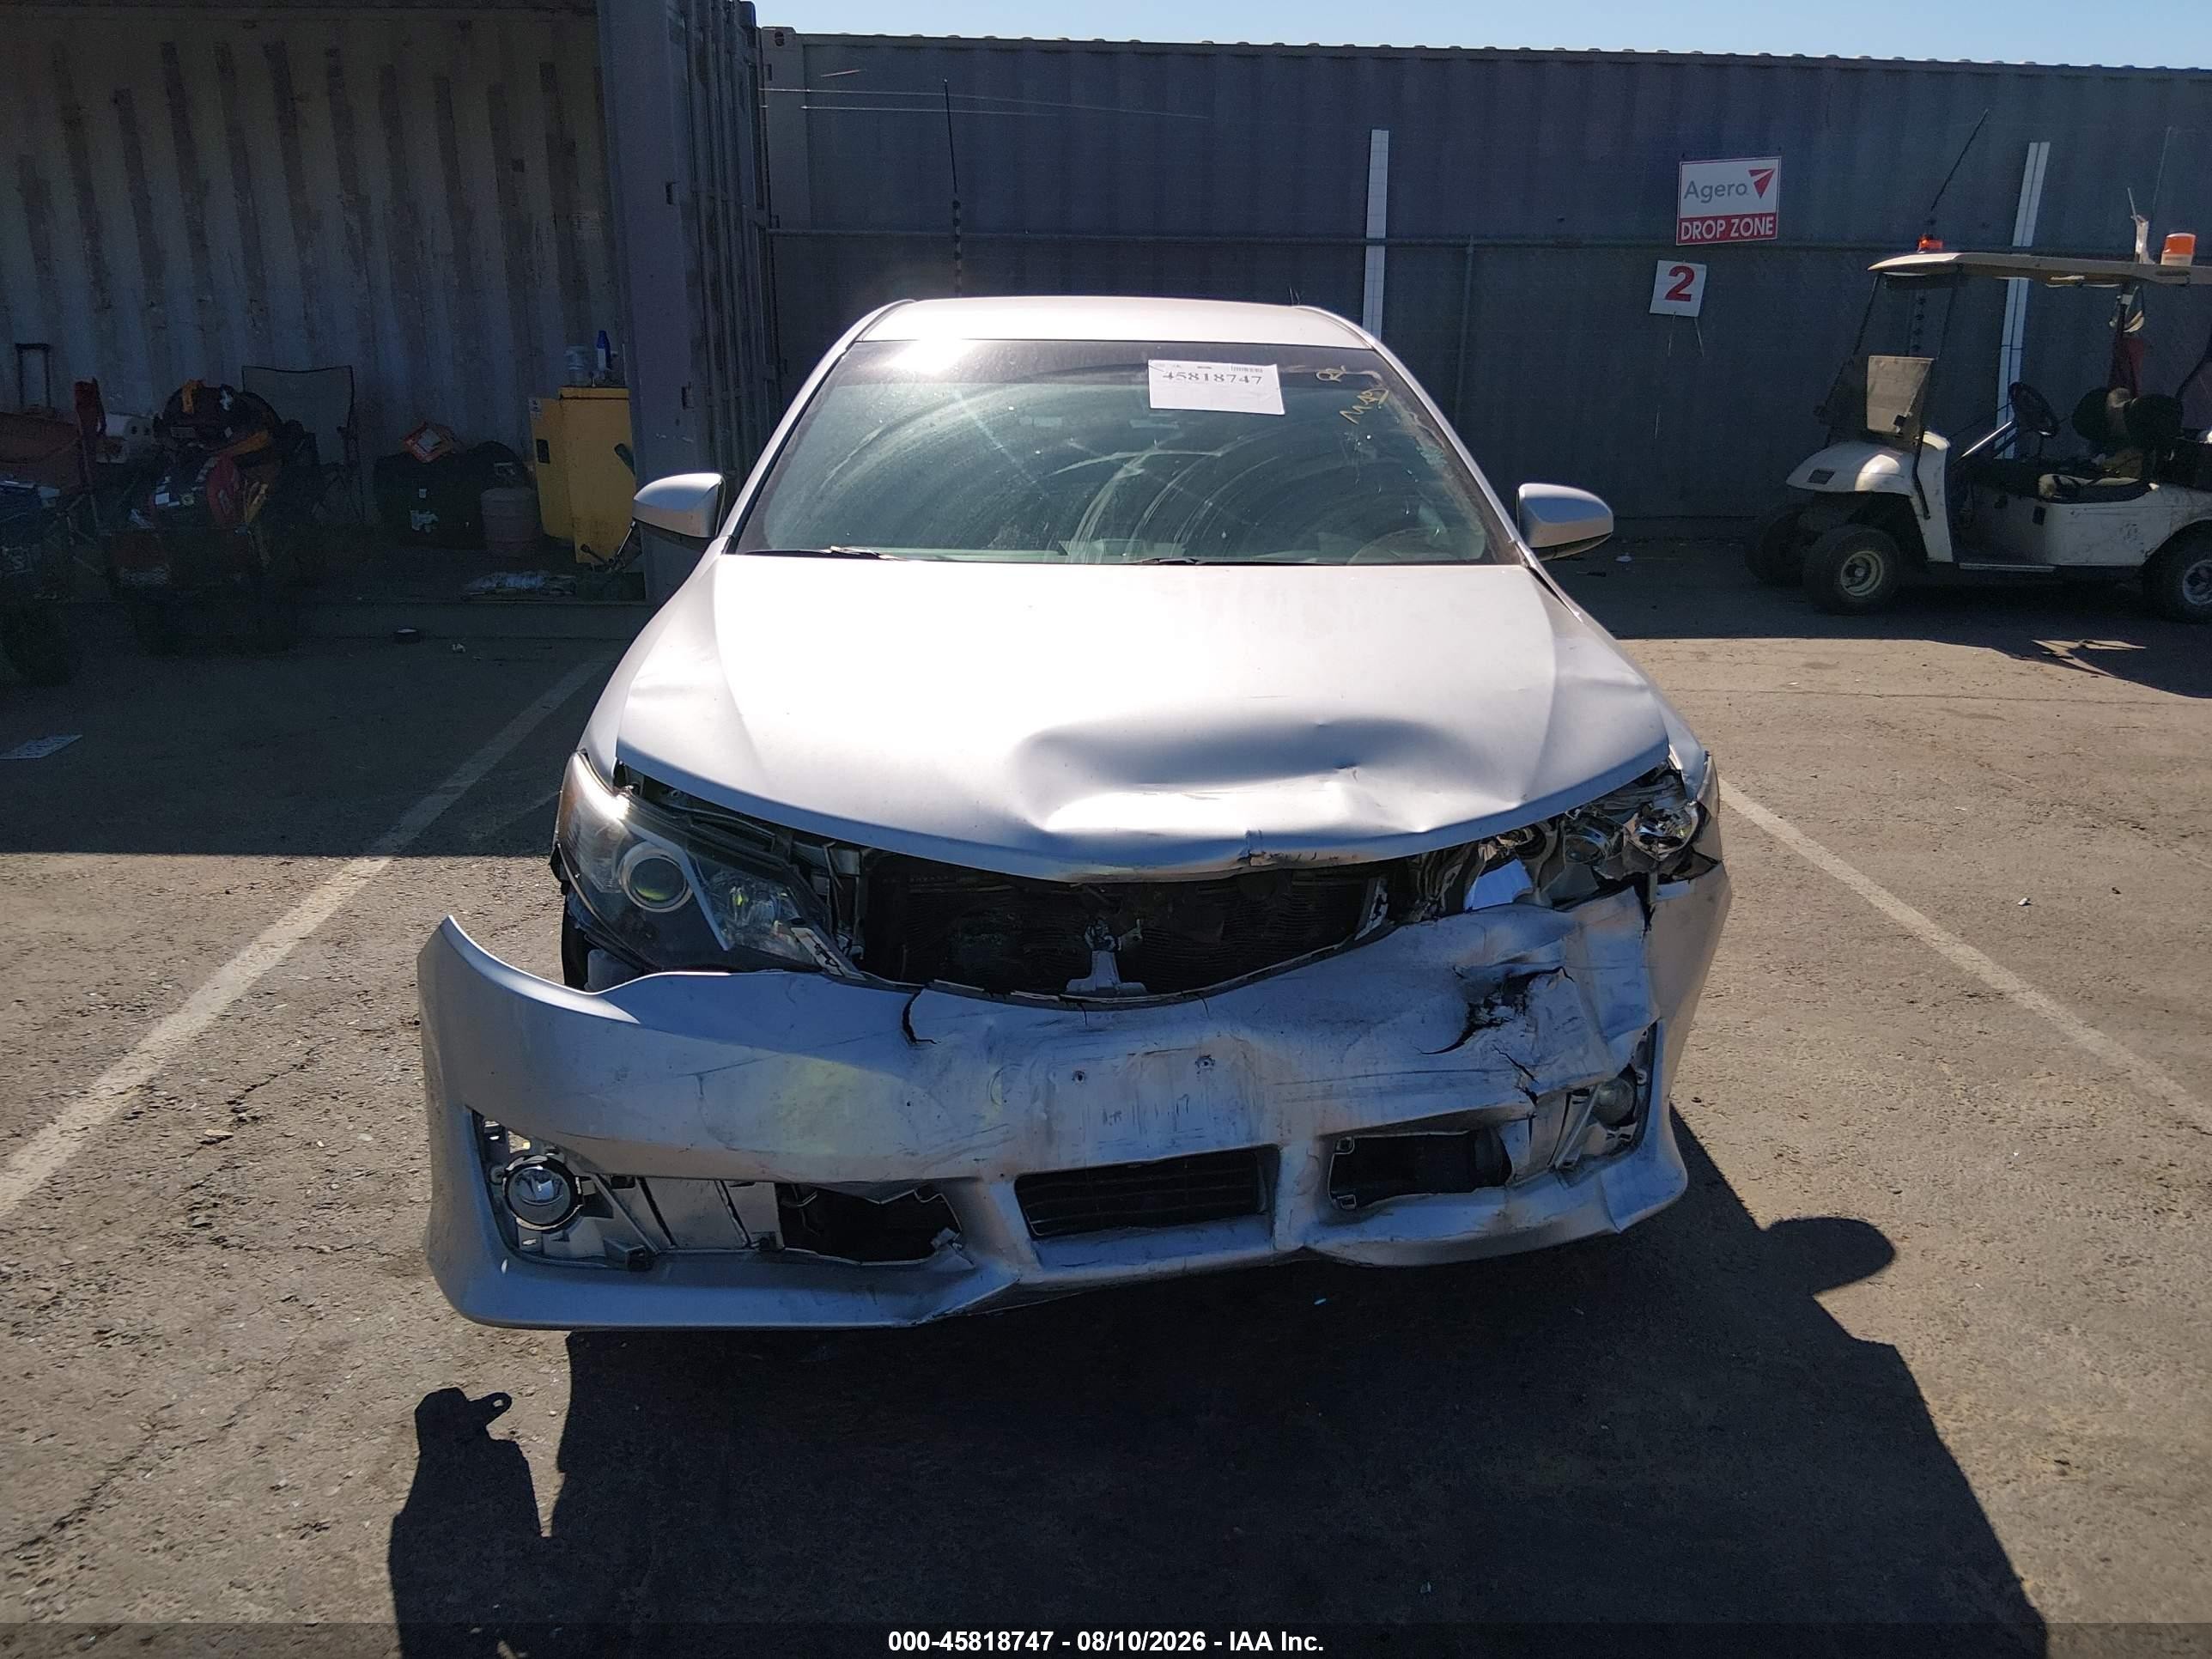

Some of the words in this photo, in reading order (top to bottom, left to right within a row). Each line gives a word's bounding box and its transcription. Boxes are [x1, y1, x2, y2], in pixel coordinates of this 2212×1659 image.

[1683, 179, 1748, 204] Agero
[1680, 220, 1726, 240] DROP
[1729, 216, 1774, 238] ZONE
[1664, 264, 1696, 302] 2
[1162, 371, 1263, 386] 45818747
